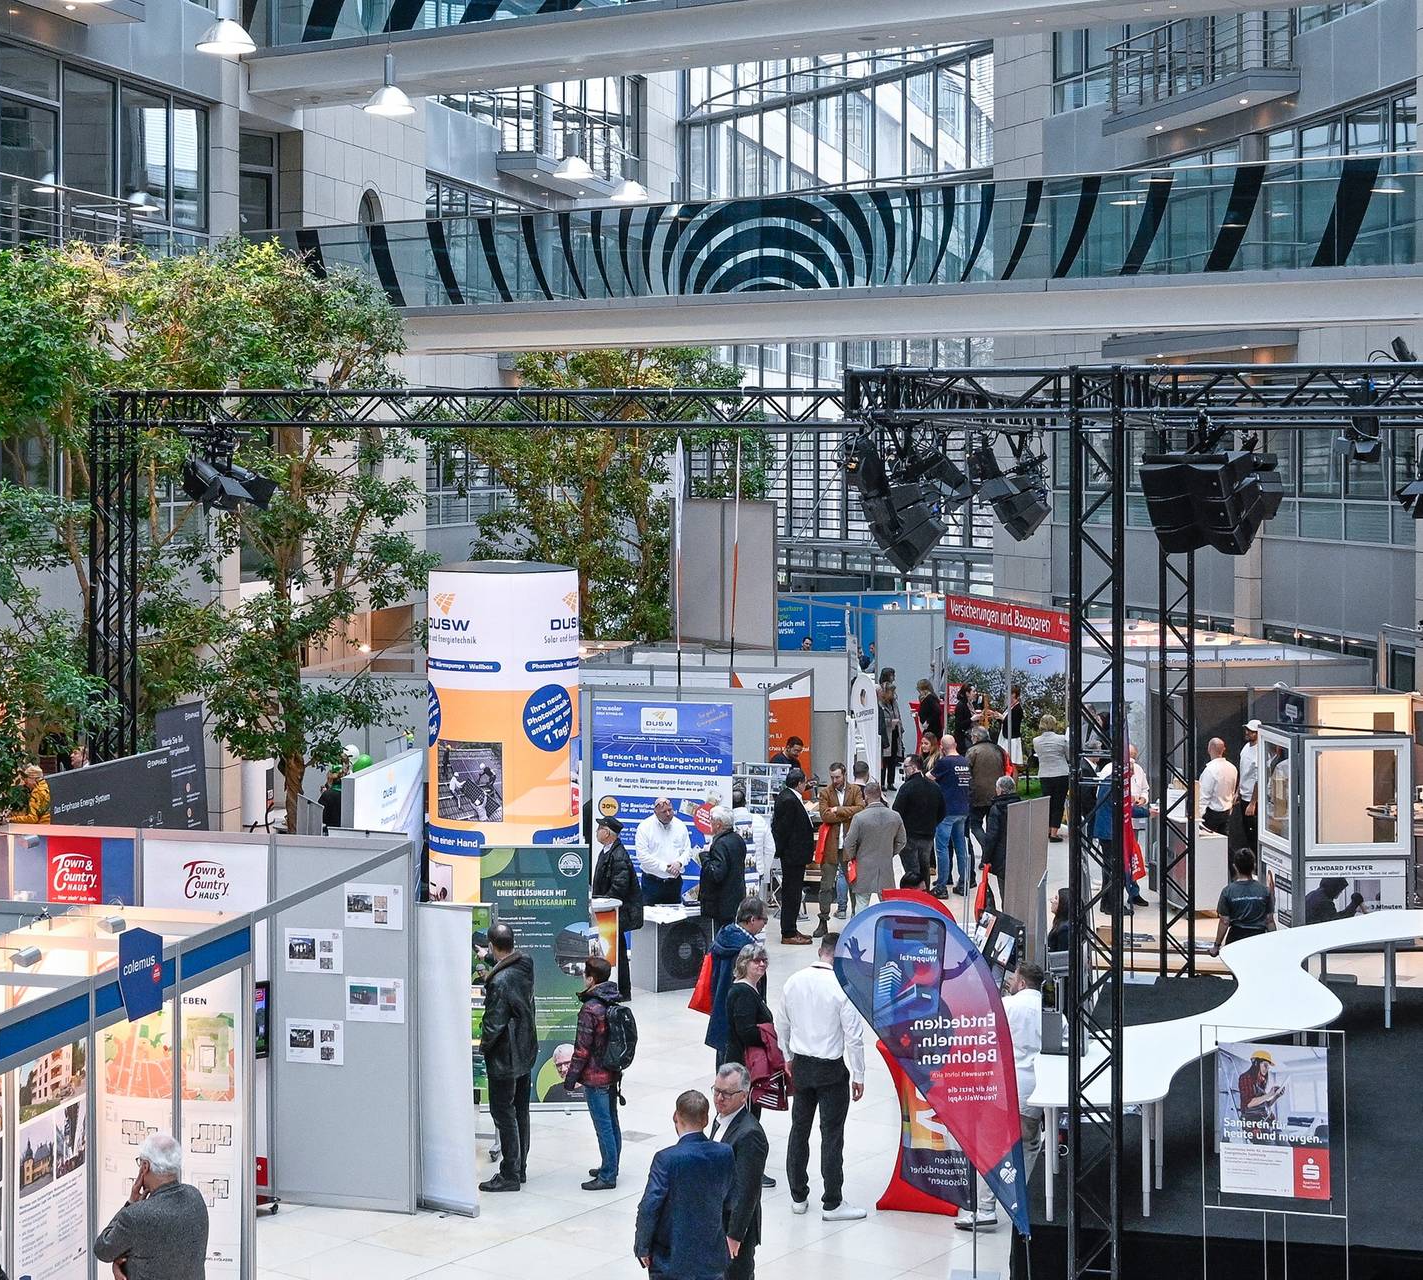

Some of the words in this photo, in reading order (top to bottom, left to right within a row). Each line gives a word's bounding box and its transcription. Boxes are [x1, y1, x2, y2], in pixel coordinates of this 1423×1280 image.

[950, 599, 999, 626] Versicherungen
[1001, 609, 1012, 625] und
[1015, 610, 1051, 634] Bausparen
[551, 617, 578, 631] DUS
[438, 635, 477, 645] Energietechnik
[544, 635, 558, 644] Solar
[530, 702, 547, 715] Ihre
[547, 693, 563, 707] neue
[526, 698, 570, 726] Photovoltaik-
[530, 721, 554, 736] anlage
[555, 714, 563, 724] an
[544, 734, 552, 745] 1
[552, 722, 570, 741] Tag!
[635, 753, 648, 761] Sie
[651, 755, 704, 764] wirkungsvoll
[640, 761, 656, 769] und
[658, 762, 718, 772] Gasrechnung!
[440, 836, 456, 846] einer
[457, 835, 478, 848] Hand
[53, 868, 98, 892] Country
[184, 875, 230, 899] Country
[497, 889, 554, 897] ENERGIELÖSUNGEN
[198, 892, 220, 900] HAUS
[513, 898, 577, 906] QUALITÄTSGARANTIE
[123, 955, 156, 976] colemus
[183, 997, 207, 1005] EBEN
[1224, 1117, 1270, 1129] Sanieren
[1271, 1119, 1286, 1129] für
[1224, 1128, 1254, 1140] heute
[1256, 1130, 1276, 1140] und
[1278, 1133, 1323, 1145] morgen.
